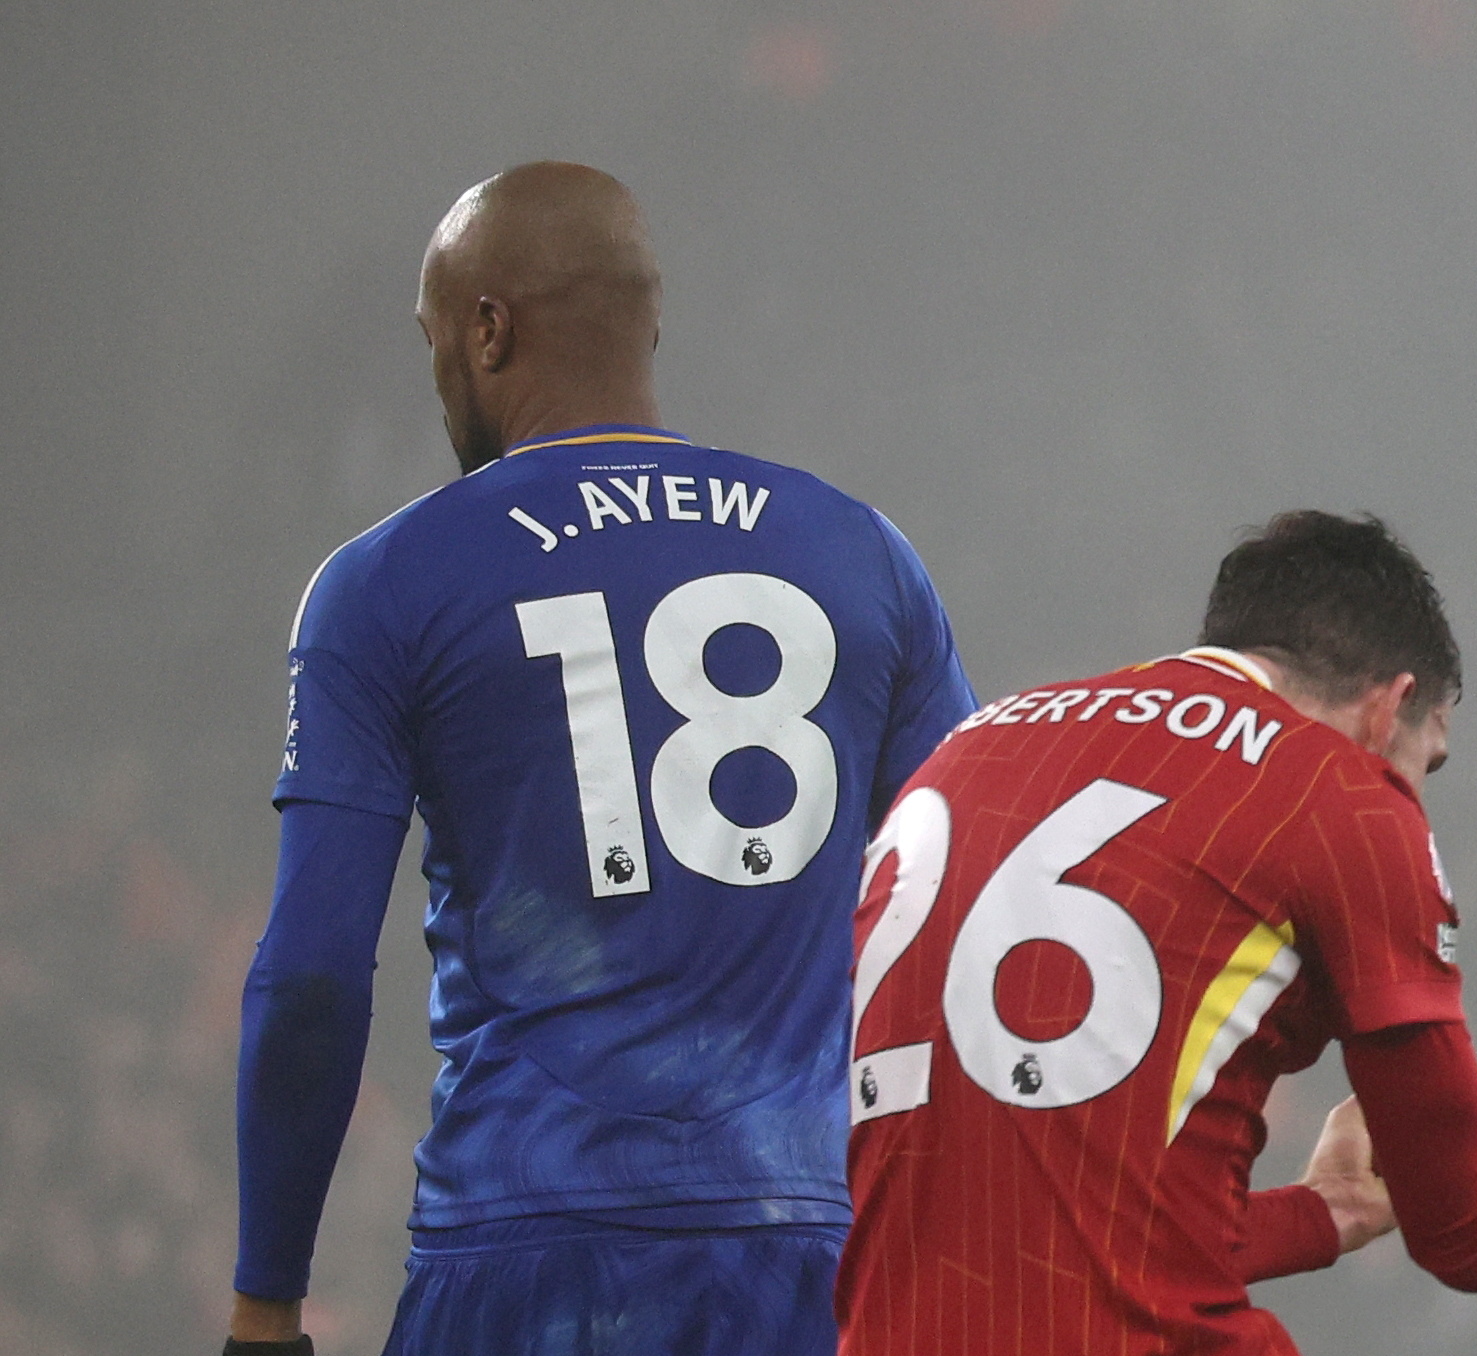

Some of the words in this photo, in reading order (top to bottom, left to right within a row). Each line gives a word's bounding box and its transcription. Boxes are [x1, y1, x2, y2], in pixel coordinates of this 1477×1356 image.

[515, 572, 838, 898] 18
[934, 687, 1283, 766] BERTSON
[850, 777, 1168, 1126] 26
